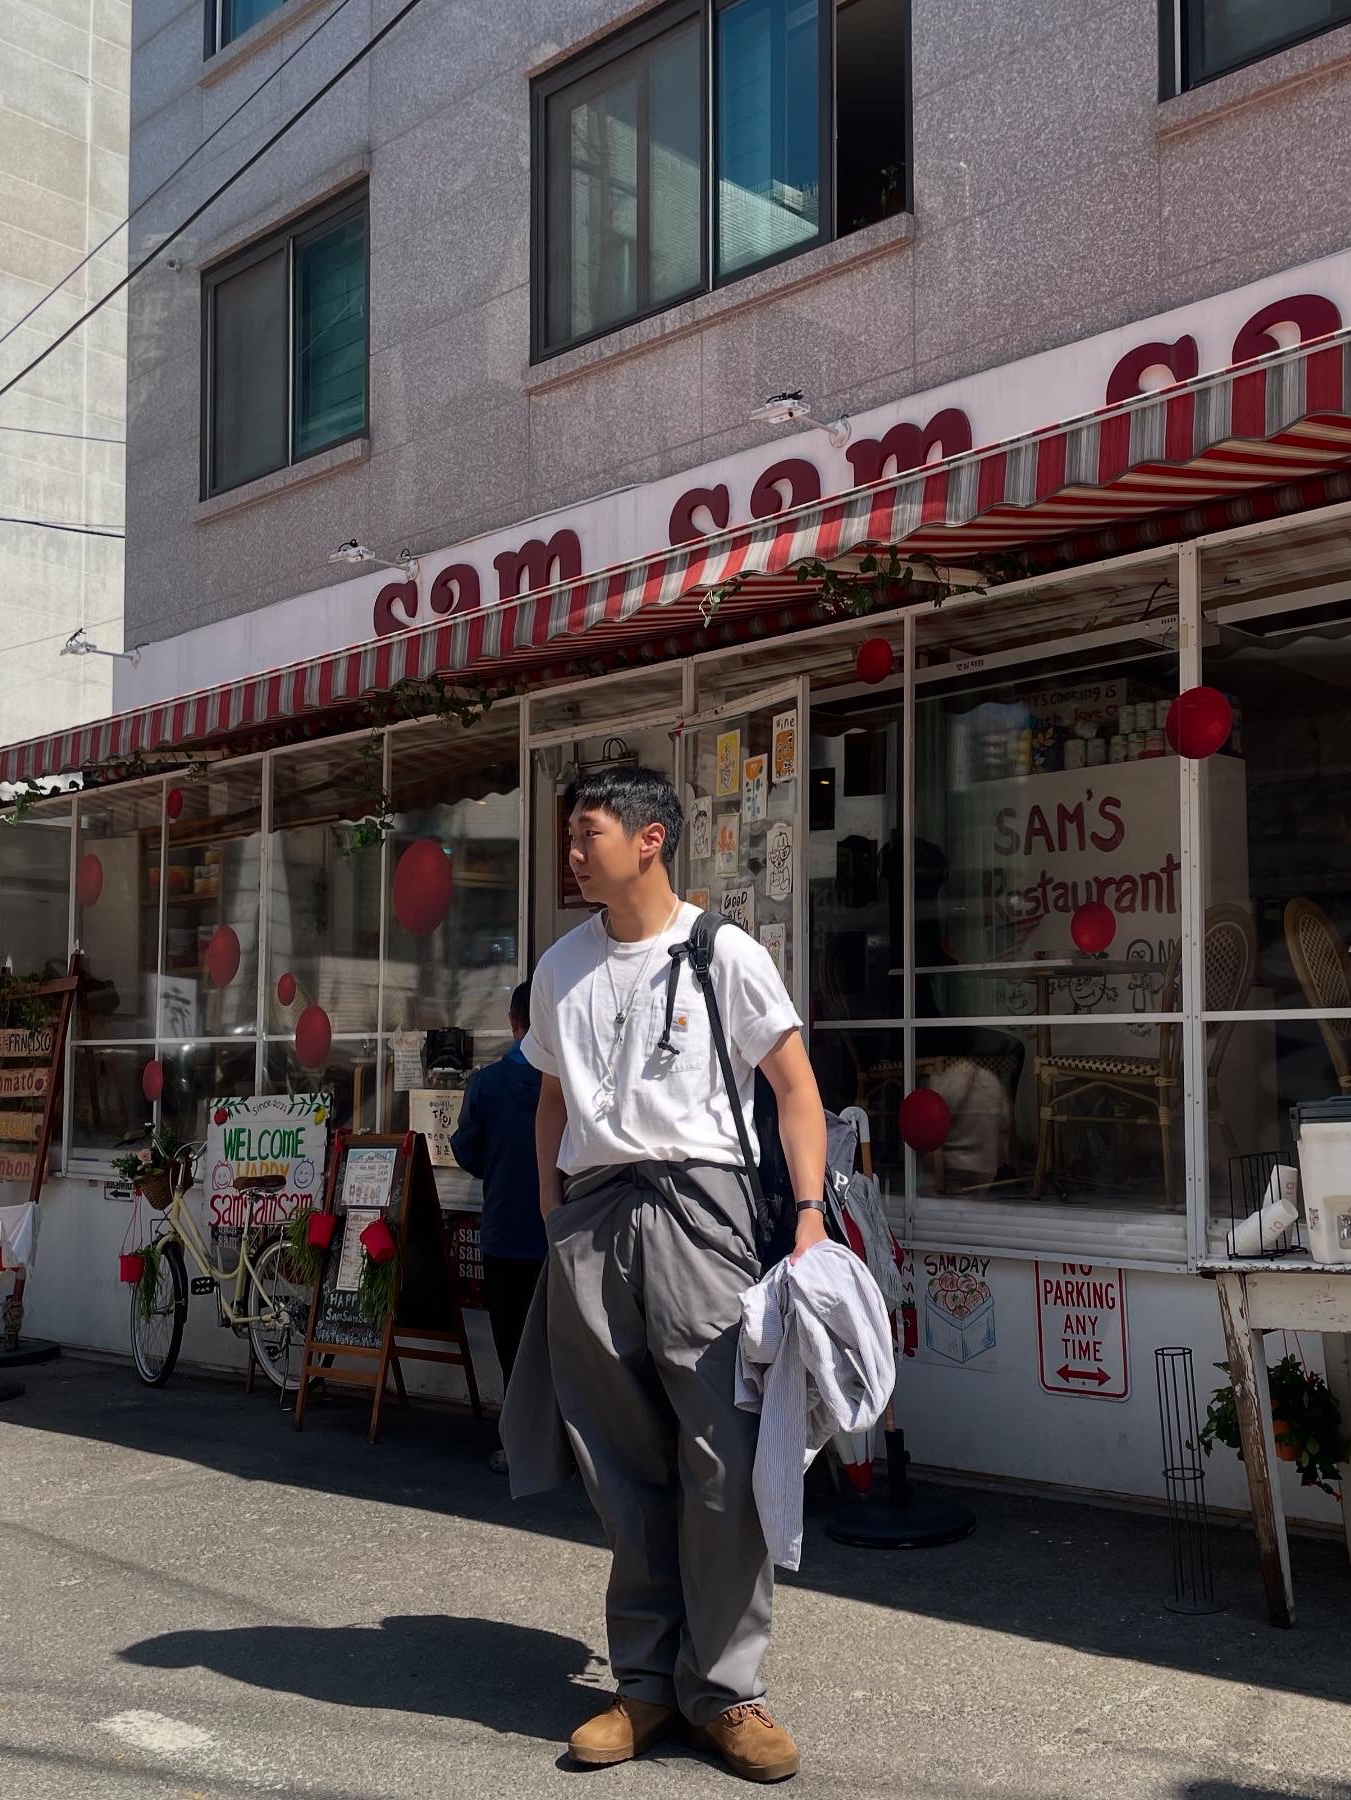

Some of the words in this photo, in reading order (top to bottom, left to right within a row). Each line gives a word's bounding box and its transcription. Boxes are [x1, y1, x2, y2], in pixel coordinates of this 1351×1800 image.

[995, 788, 1125, 856] SAM'S
[724, 892, 747, 909] GOOD
[224, 1127, 306, 1161] WELCOME
[924, 1255, 990, 1277] SAMDAY
[1044, 1279, 1115, 1310] PARKING
[1064, 1314, 1098, 1336] ANY
[1061, 1338, 1103, 1362] TIME
